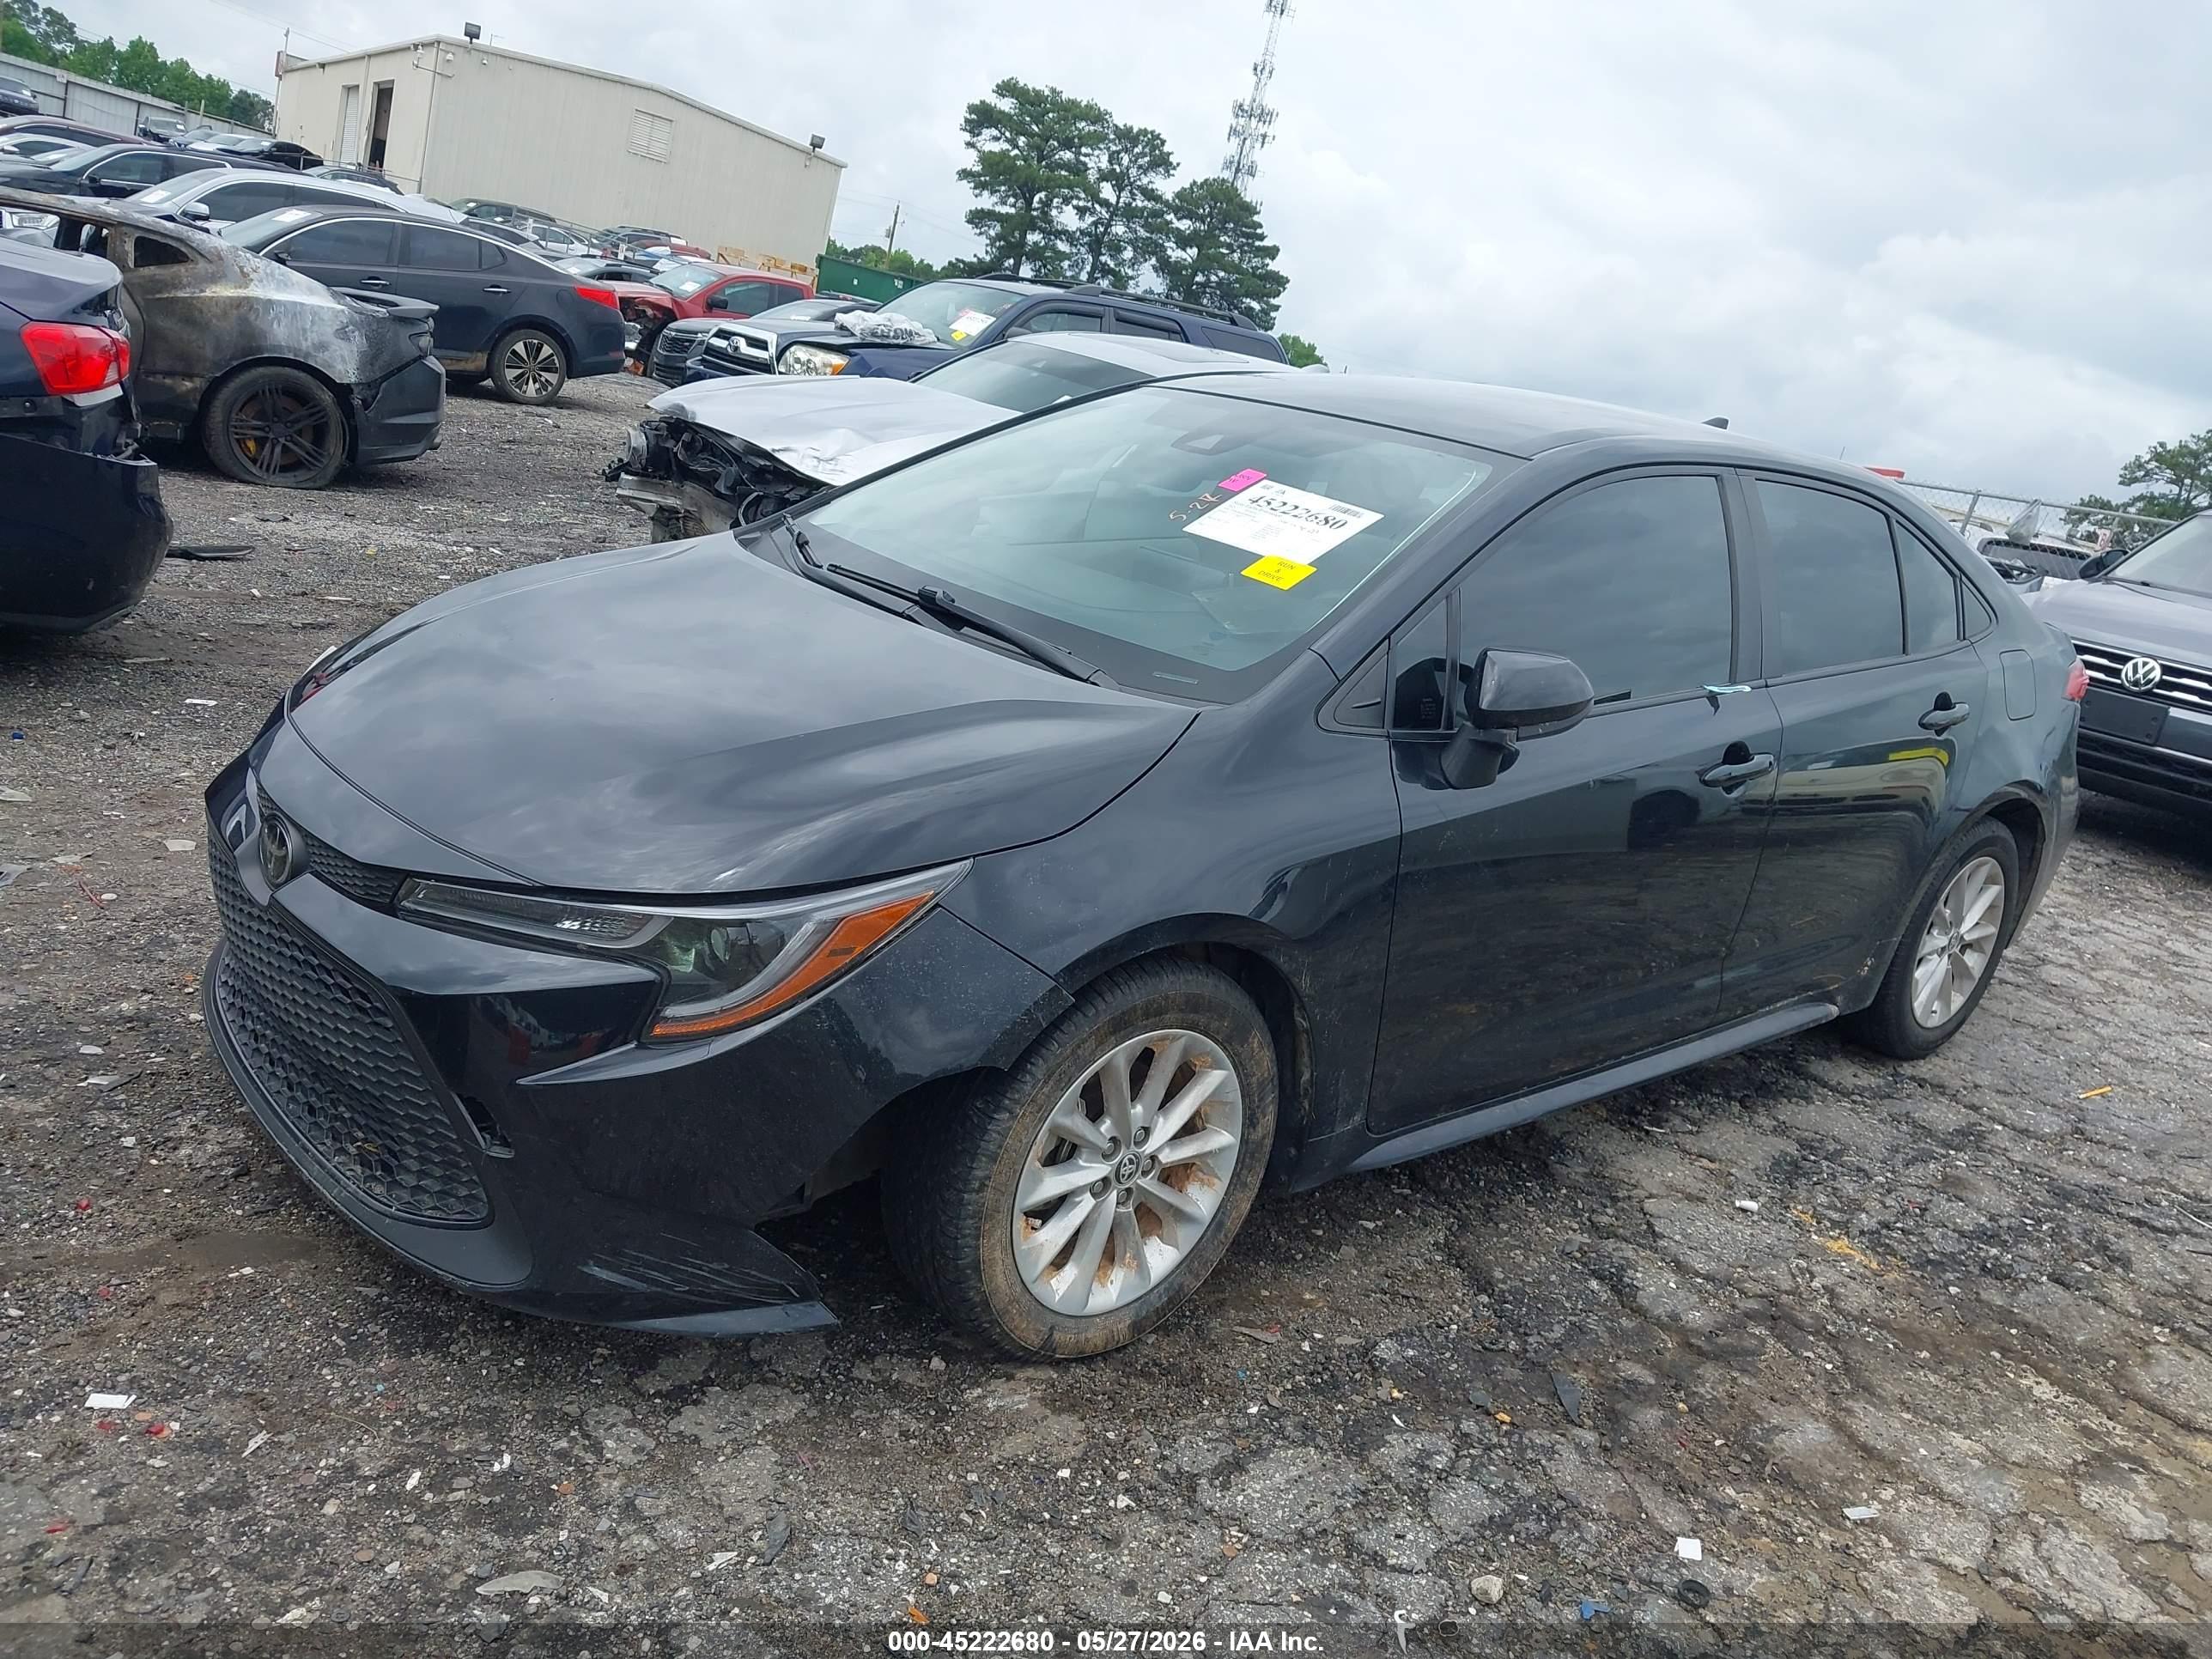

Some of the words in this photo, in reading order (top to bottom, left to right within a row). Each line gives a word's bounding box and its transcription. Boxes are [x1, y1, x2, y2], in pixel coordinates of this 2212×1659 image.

[1248, 495, 1348, 530] 45222680
[1277, 561, 1297, 570] RUN
[1257, 570, 1285, 582] DRIVE
